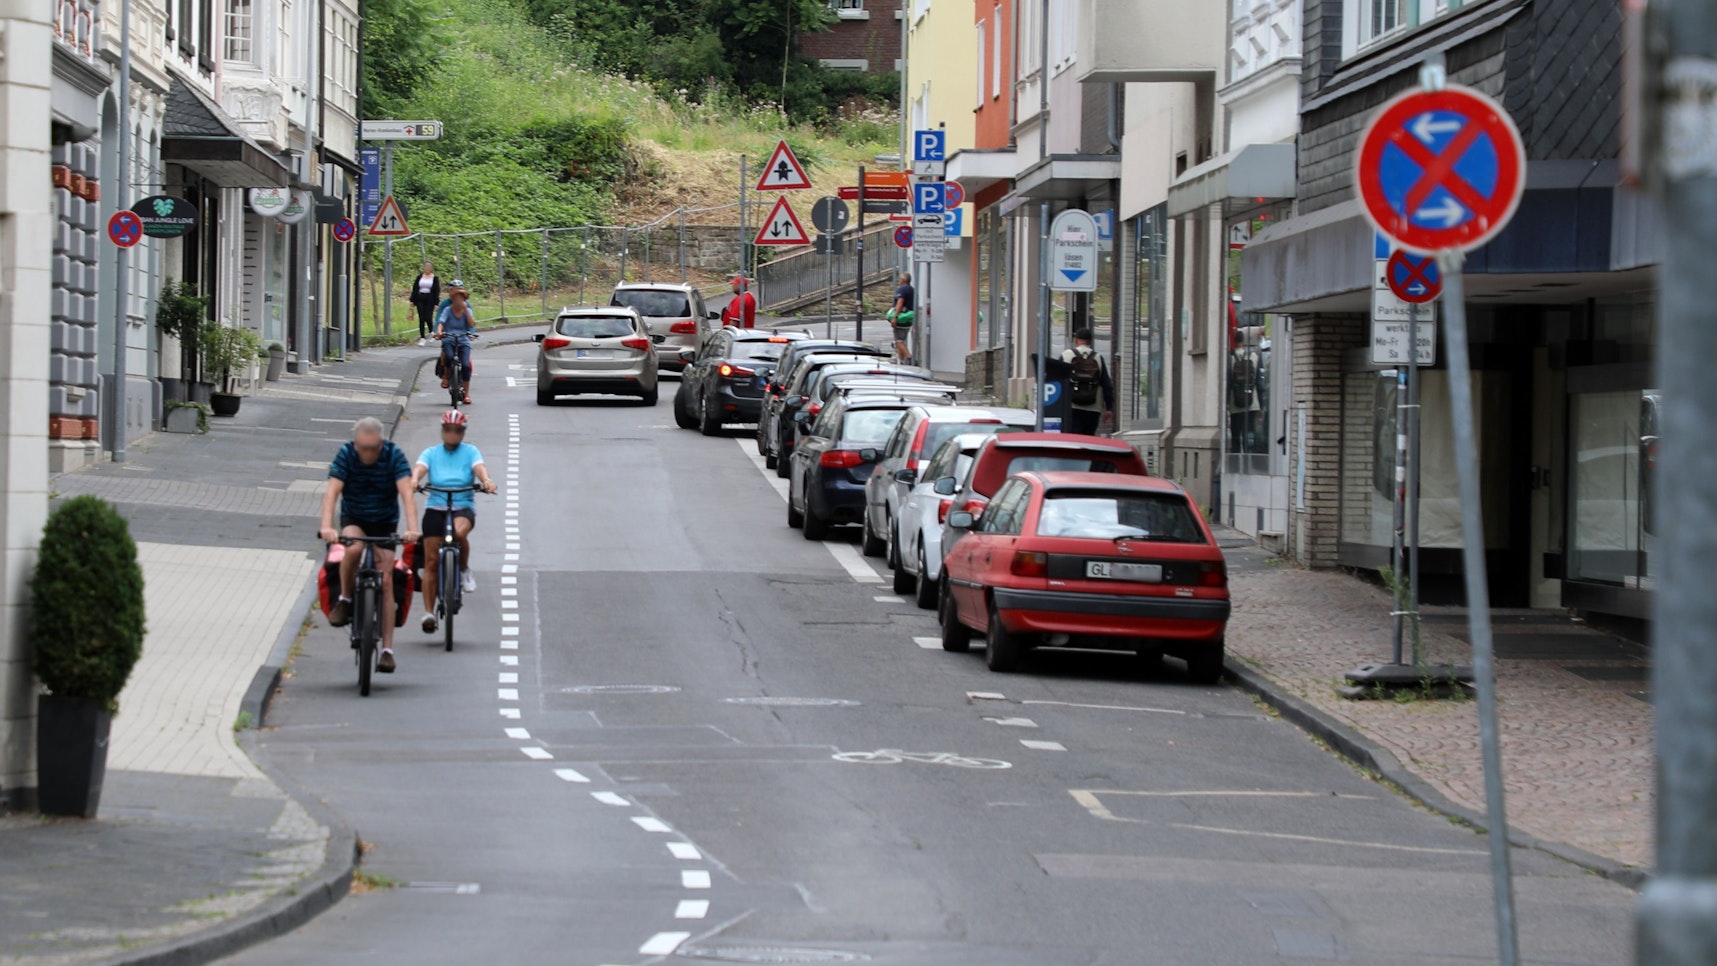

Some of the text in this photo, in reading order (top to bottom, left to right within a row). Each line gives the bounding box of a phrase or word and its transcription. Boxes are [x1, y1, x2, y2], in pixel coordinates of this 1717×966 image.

[422, 125, 434, 136] 59
[921, 134, 938, 158] P
[921, 186, 938, 210] P
[1055, 239, 1093, 247] Parkschein
[1378, 305, 1430, 316] Parkscein
[1376, 337, 1399, 347] Mo-Fr
[1389, 349, 1399, 359] Sa
[1044, 384, 1056, 401] P
